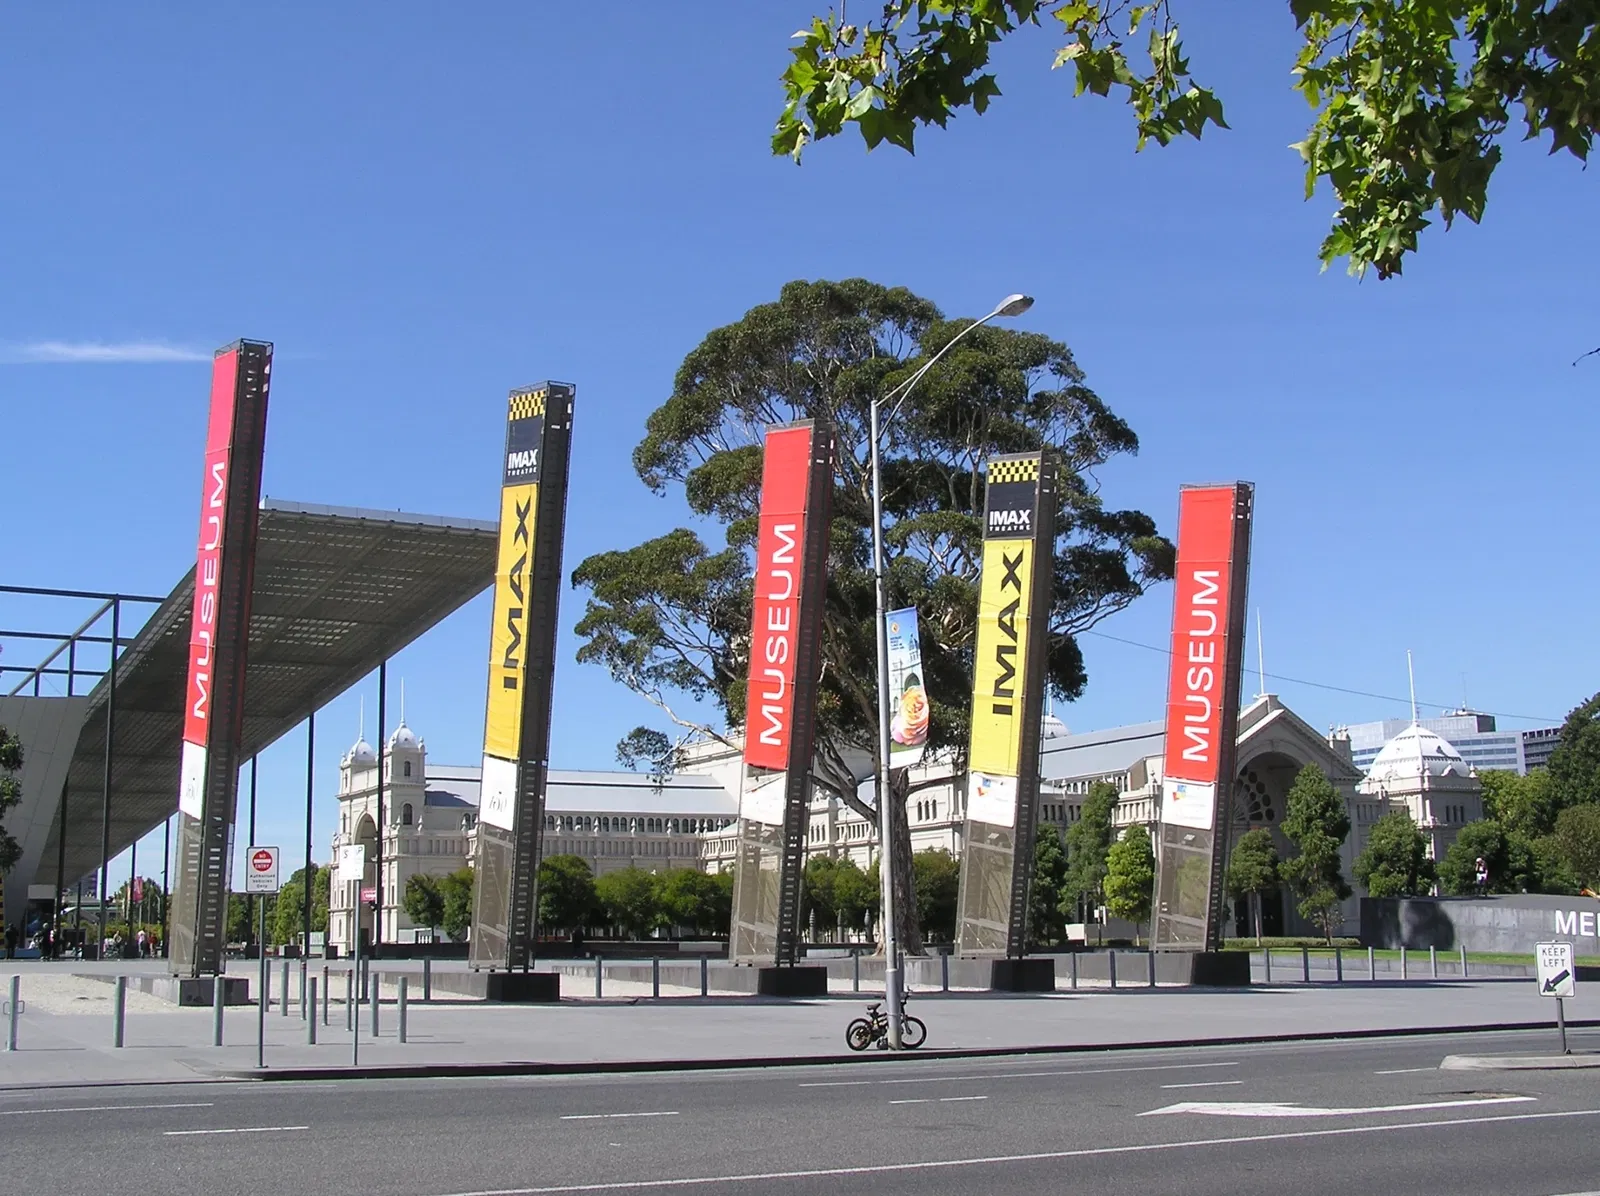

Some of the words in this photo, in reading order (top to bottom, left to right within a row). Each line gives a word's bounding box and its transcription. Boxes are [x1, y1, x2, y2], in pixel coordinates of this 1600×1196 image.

[507, 467, 537, 476] THEATRE
[508, 449, 539, 469] IMAX
[989, 509, 1031, 525] IMAX
[193, 461, 225, 719] MUSEUM
[503, 495, 532, 689] IMAX
[759, 523, 796, 746] MUSEUM
[992, 548, 1024, 715] IMAX
[1182, 570, 1219, 762] MUSEUM
[1555, 909, 1600, 937] ME
[1542, 947, 1566, 956] KEEP
[1543, 959, 1566, 967] LEFT
